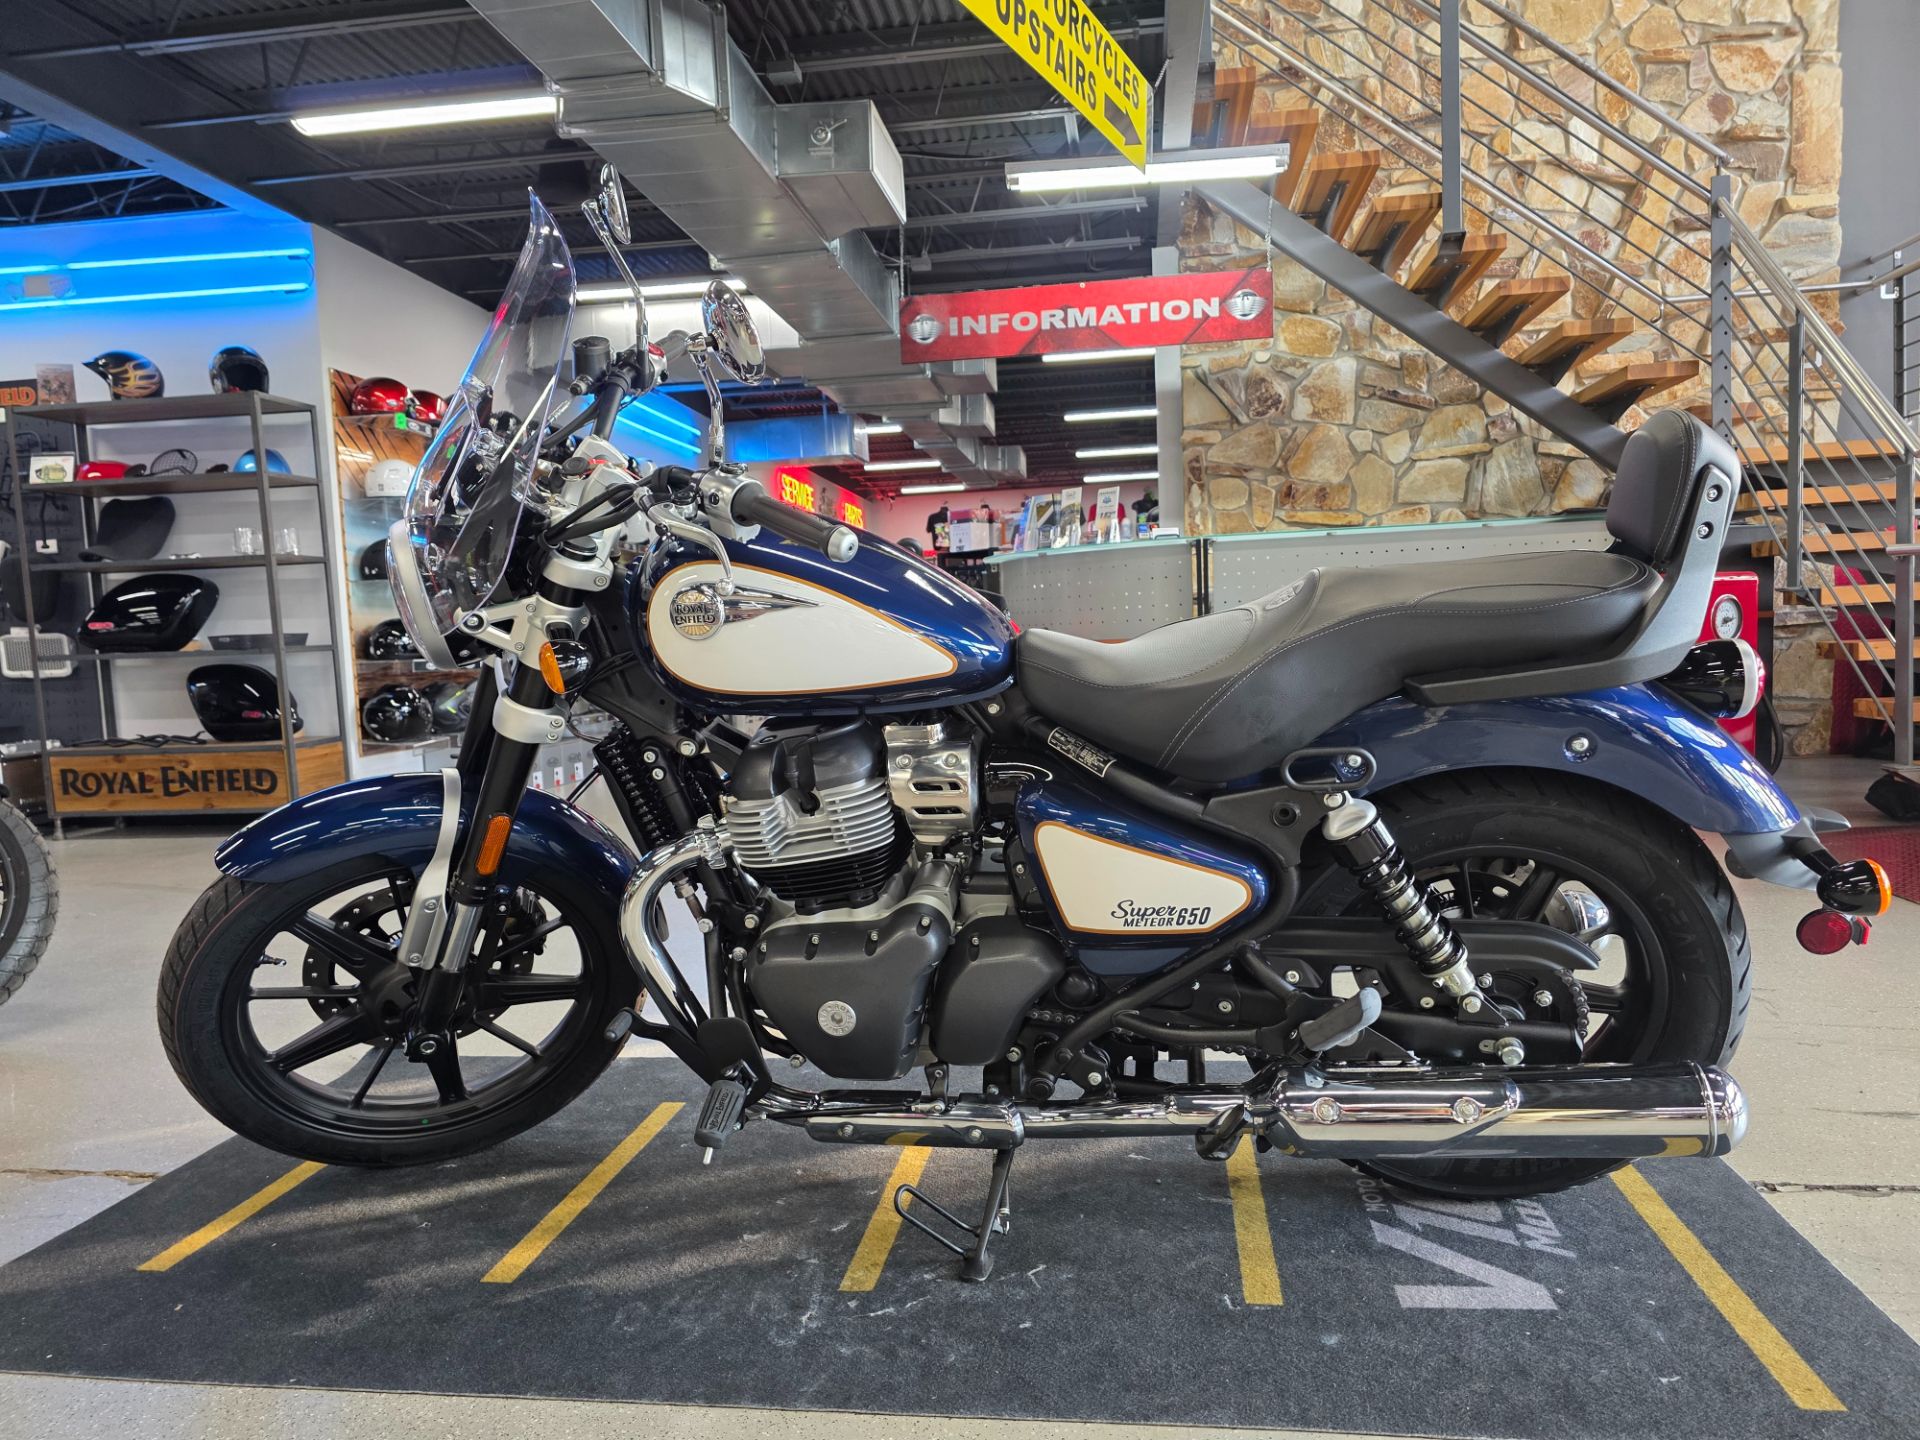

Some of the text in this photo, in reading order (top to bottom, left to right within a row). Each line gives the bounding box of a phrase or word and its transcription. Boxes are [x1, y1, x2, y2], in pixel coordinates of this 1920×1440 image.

[996, 0, 1097, 110] UPSTAIRS
[949, 296, 1220, 336] INFORMATION
[675, 603, 713, 614] ROYAL
[675, 614, 716, 625] ENFIELD
[59, 766, 278, 797] ROYAL ENFIELD
[1110, 899, 1178, 921] Super
[1123, 906, 1211, 927] METEOR 650
